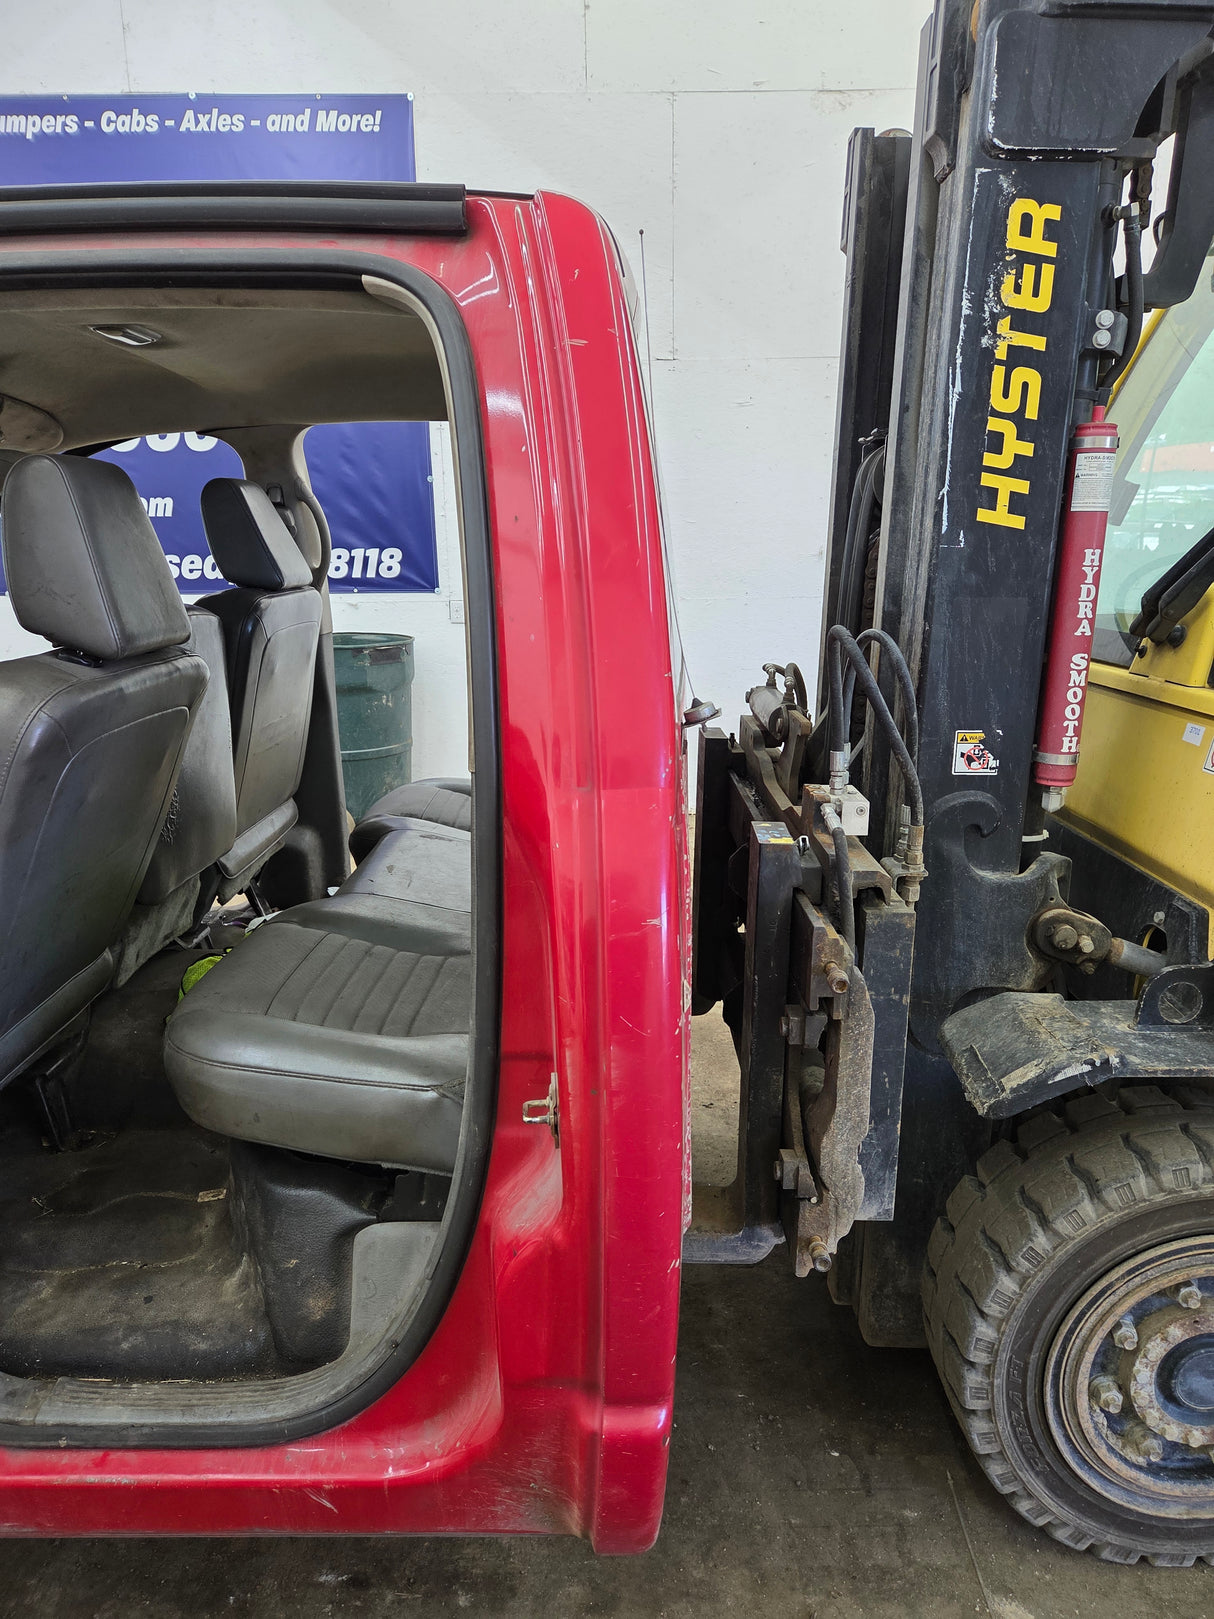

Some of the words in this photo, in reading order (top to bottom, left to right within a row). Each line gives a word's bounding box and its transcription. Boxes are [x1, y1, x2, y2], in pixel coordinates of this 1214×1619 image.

[100, 109, 159, 132] Cabs
[179, 109, 245, 132] Axles
[266, 109, 311, 132] and
[315, 110, 382, 132] More!
[976, 197, 1062, 530] HYSTER
[1074, 549, 1101, 636] HYDRA
[1061, 653, 1089, 753] SMOOTH
